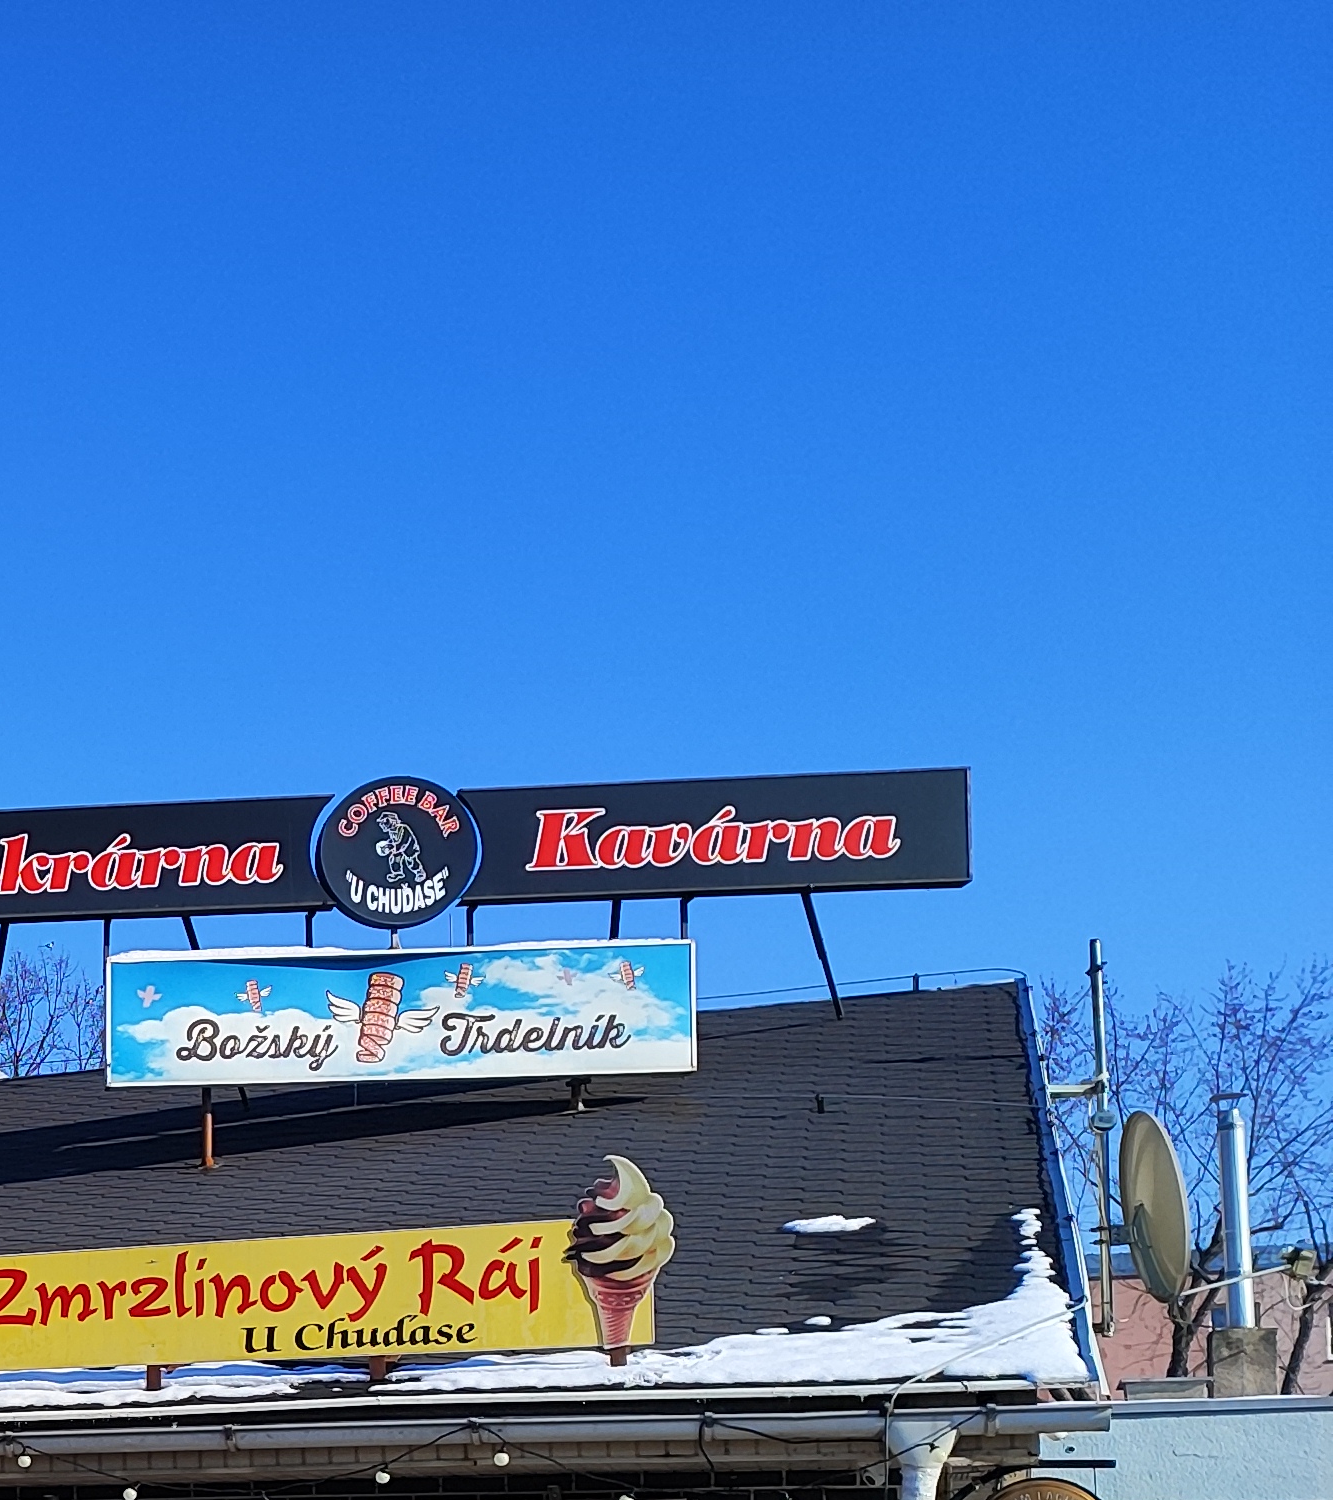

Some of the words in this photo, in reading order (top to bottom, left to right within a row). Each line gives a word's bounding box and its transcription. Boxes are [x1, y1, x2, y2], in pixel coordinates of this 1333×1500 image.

[338, 785, 418, 837] COFFEE
[418, 790, 460, 838] BAR
[526, 805, 901, 871] Kavárna
[176, 1018, 339, 1071] Božský
[439, 1012, 632, 1056] Trdelník
[408, 1235, 548, 1318] Ráj
[240, 1325, 282, 1355] U
